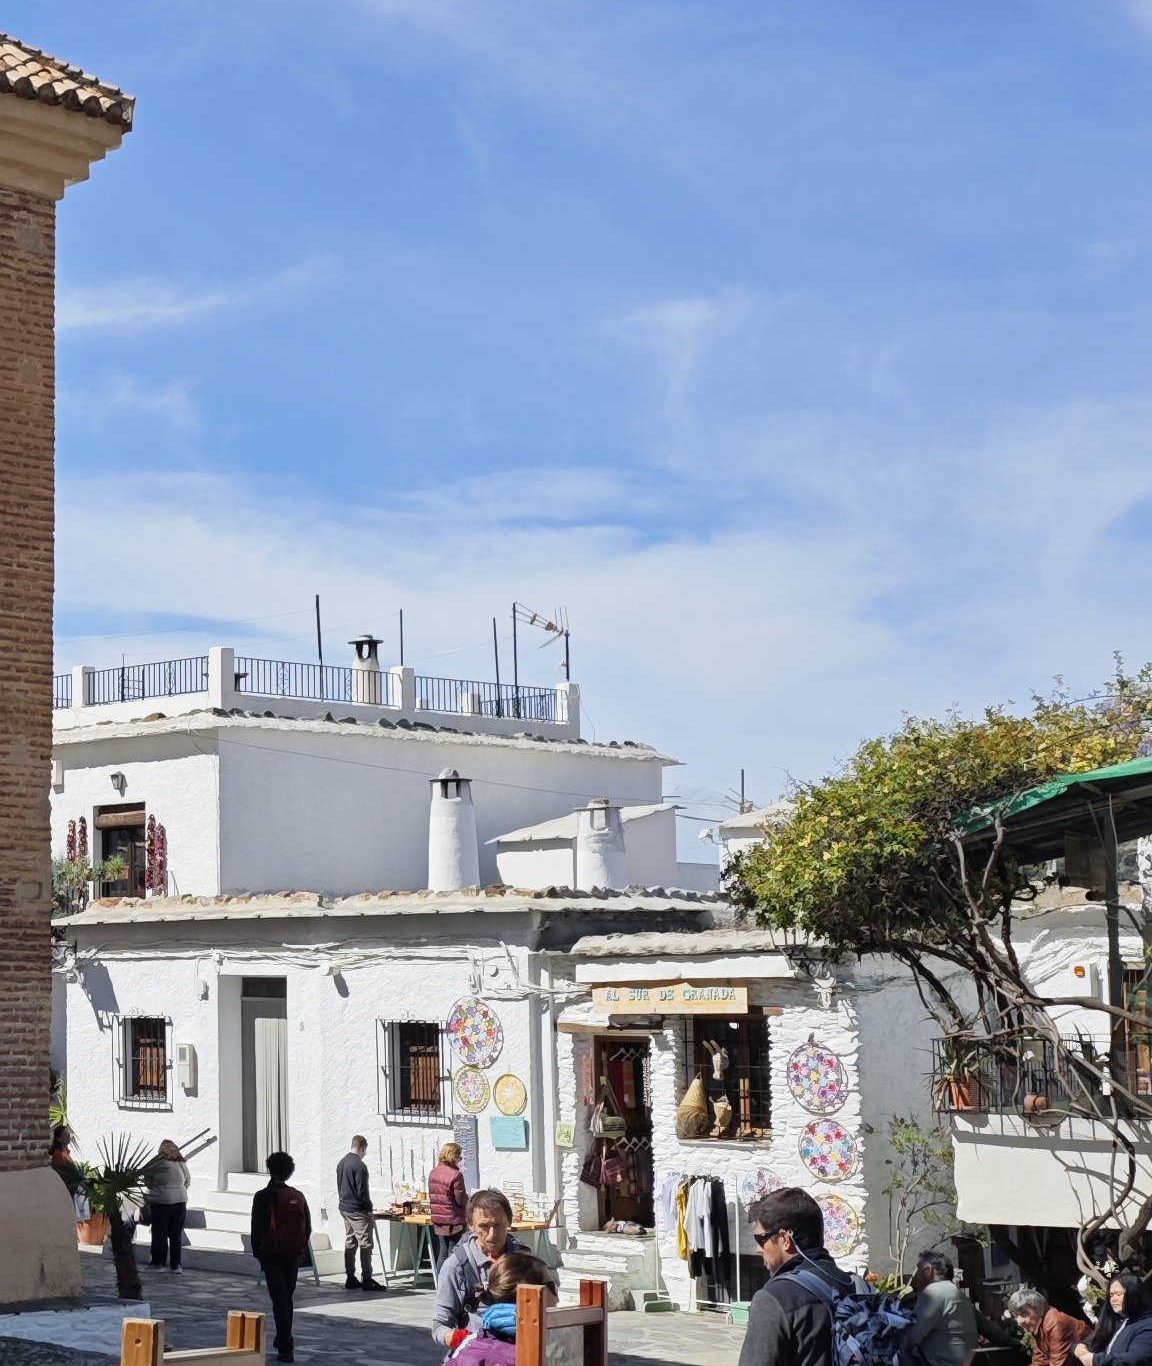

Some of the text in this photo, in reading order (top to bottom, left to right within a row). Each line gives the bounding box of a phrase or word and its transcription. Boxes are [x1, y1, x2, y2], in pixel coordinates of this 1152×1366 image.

[606, 988, 736, 1002] AL SUR DE GRANADA
